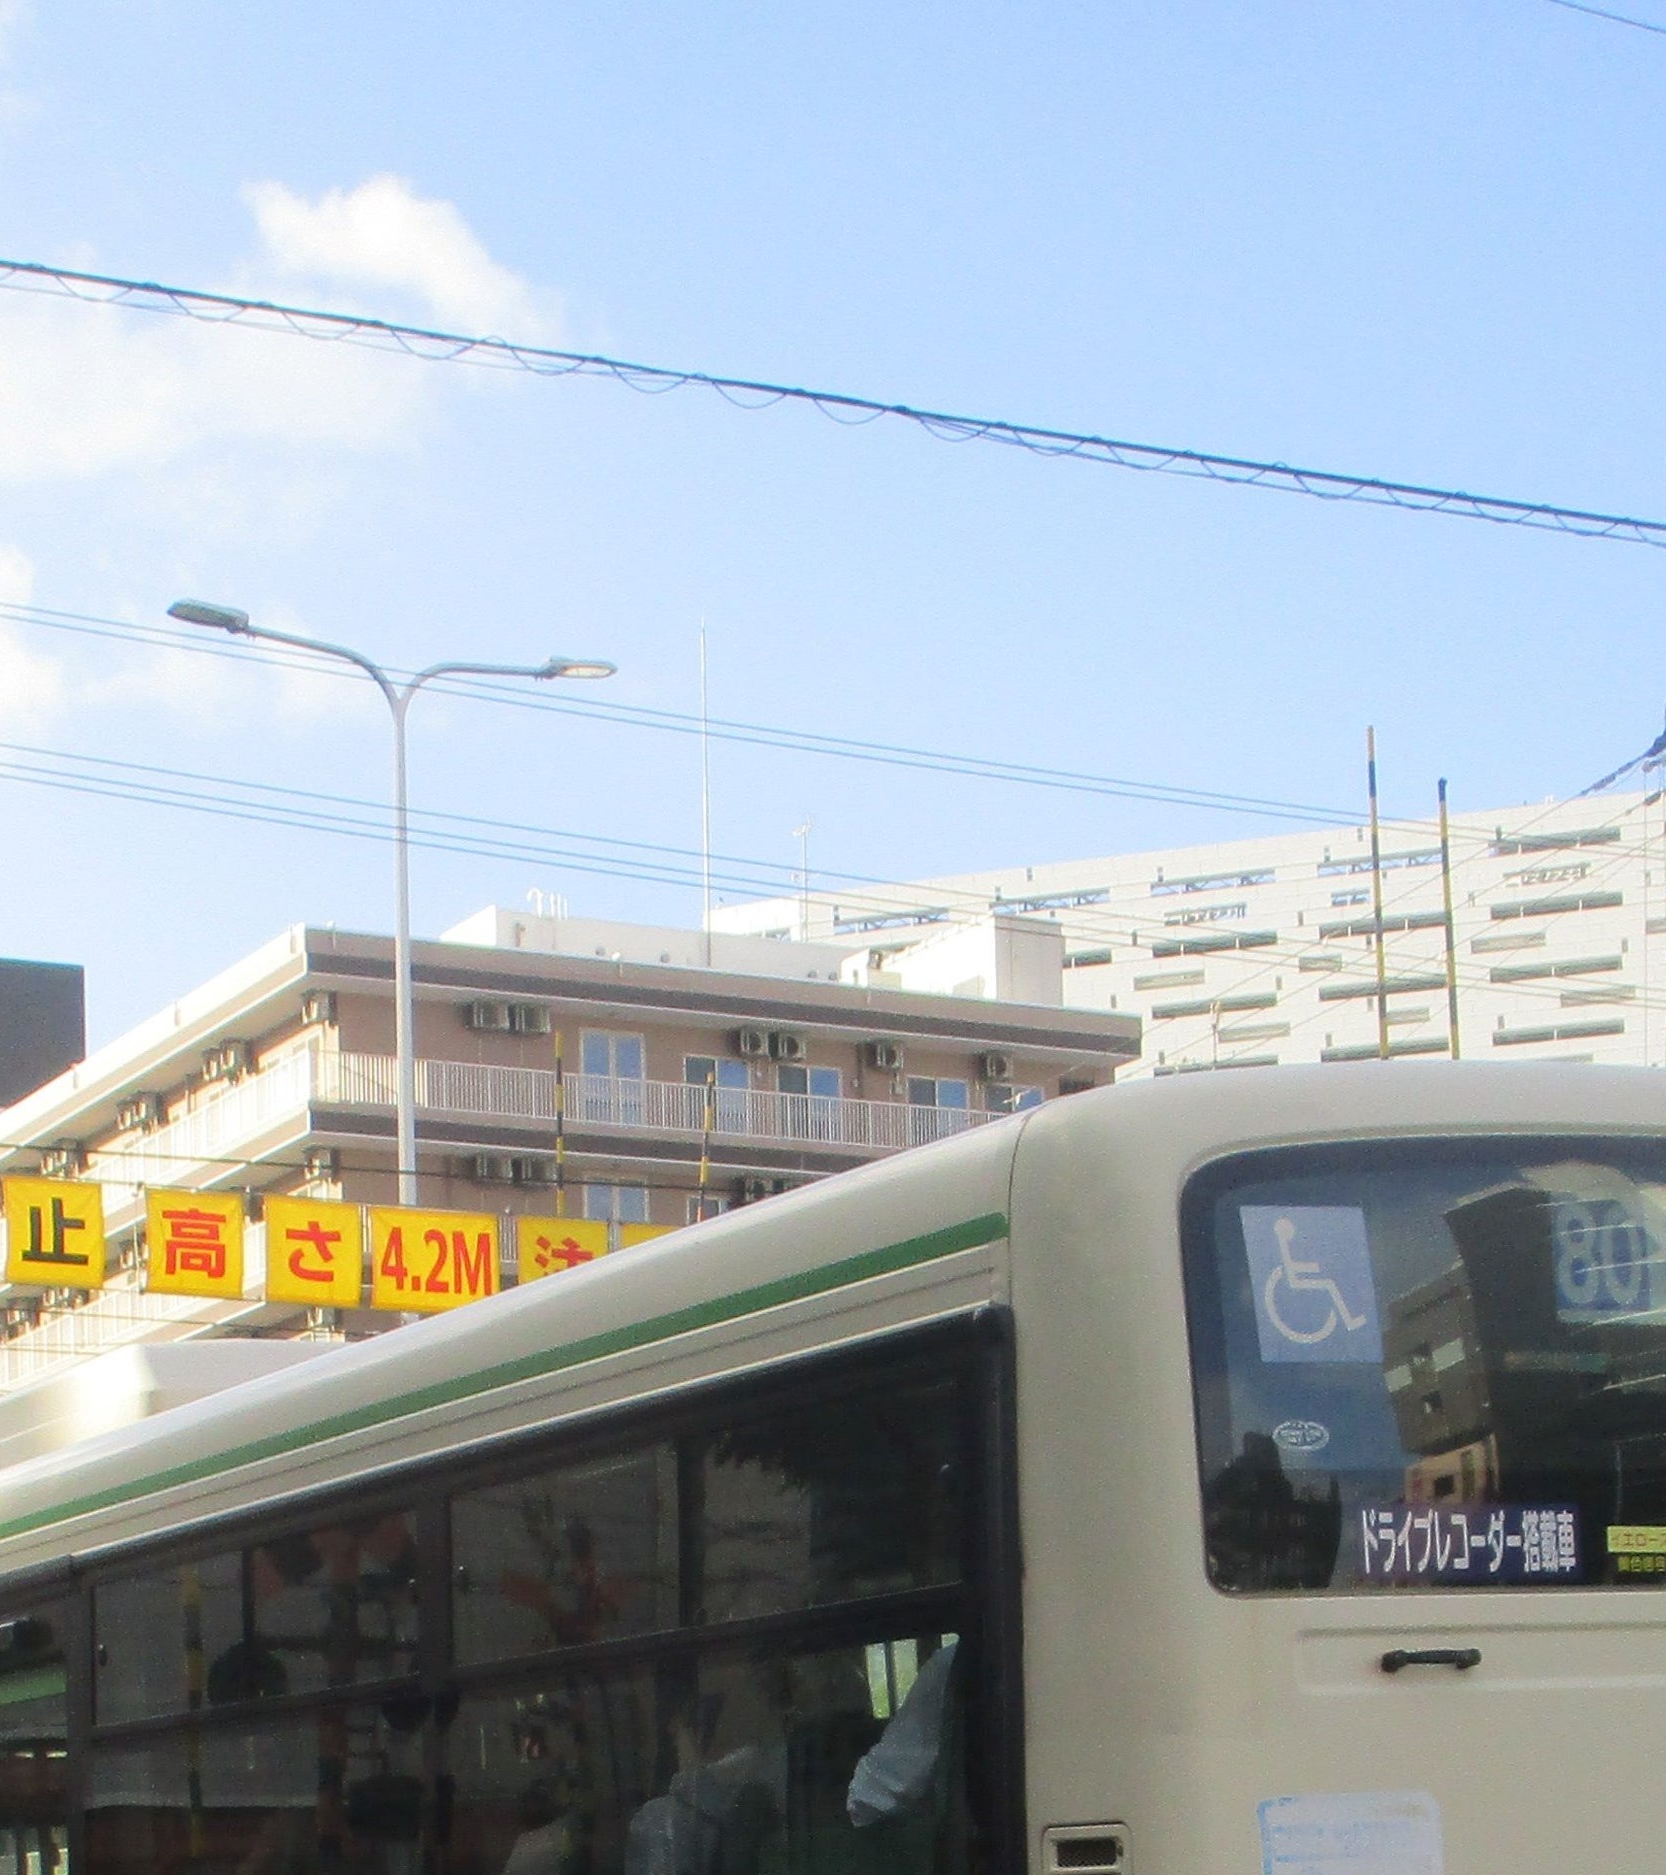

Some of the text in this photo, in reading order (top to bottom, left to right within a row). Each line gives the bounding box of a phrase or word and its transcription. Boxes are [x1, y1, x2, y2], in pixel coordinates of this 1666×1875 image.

[1362, 1509, 1576, 1574] ドライブレコーダー搭載車
